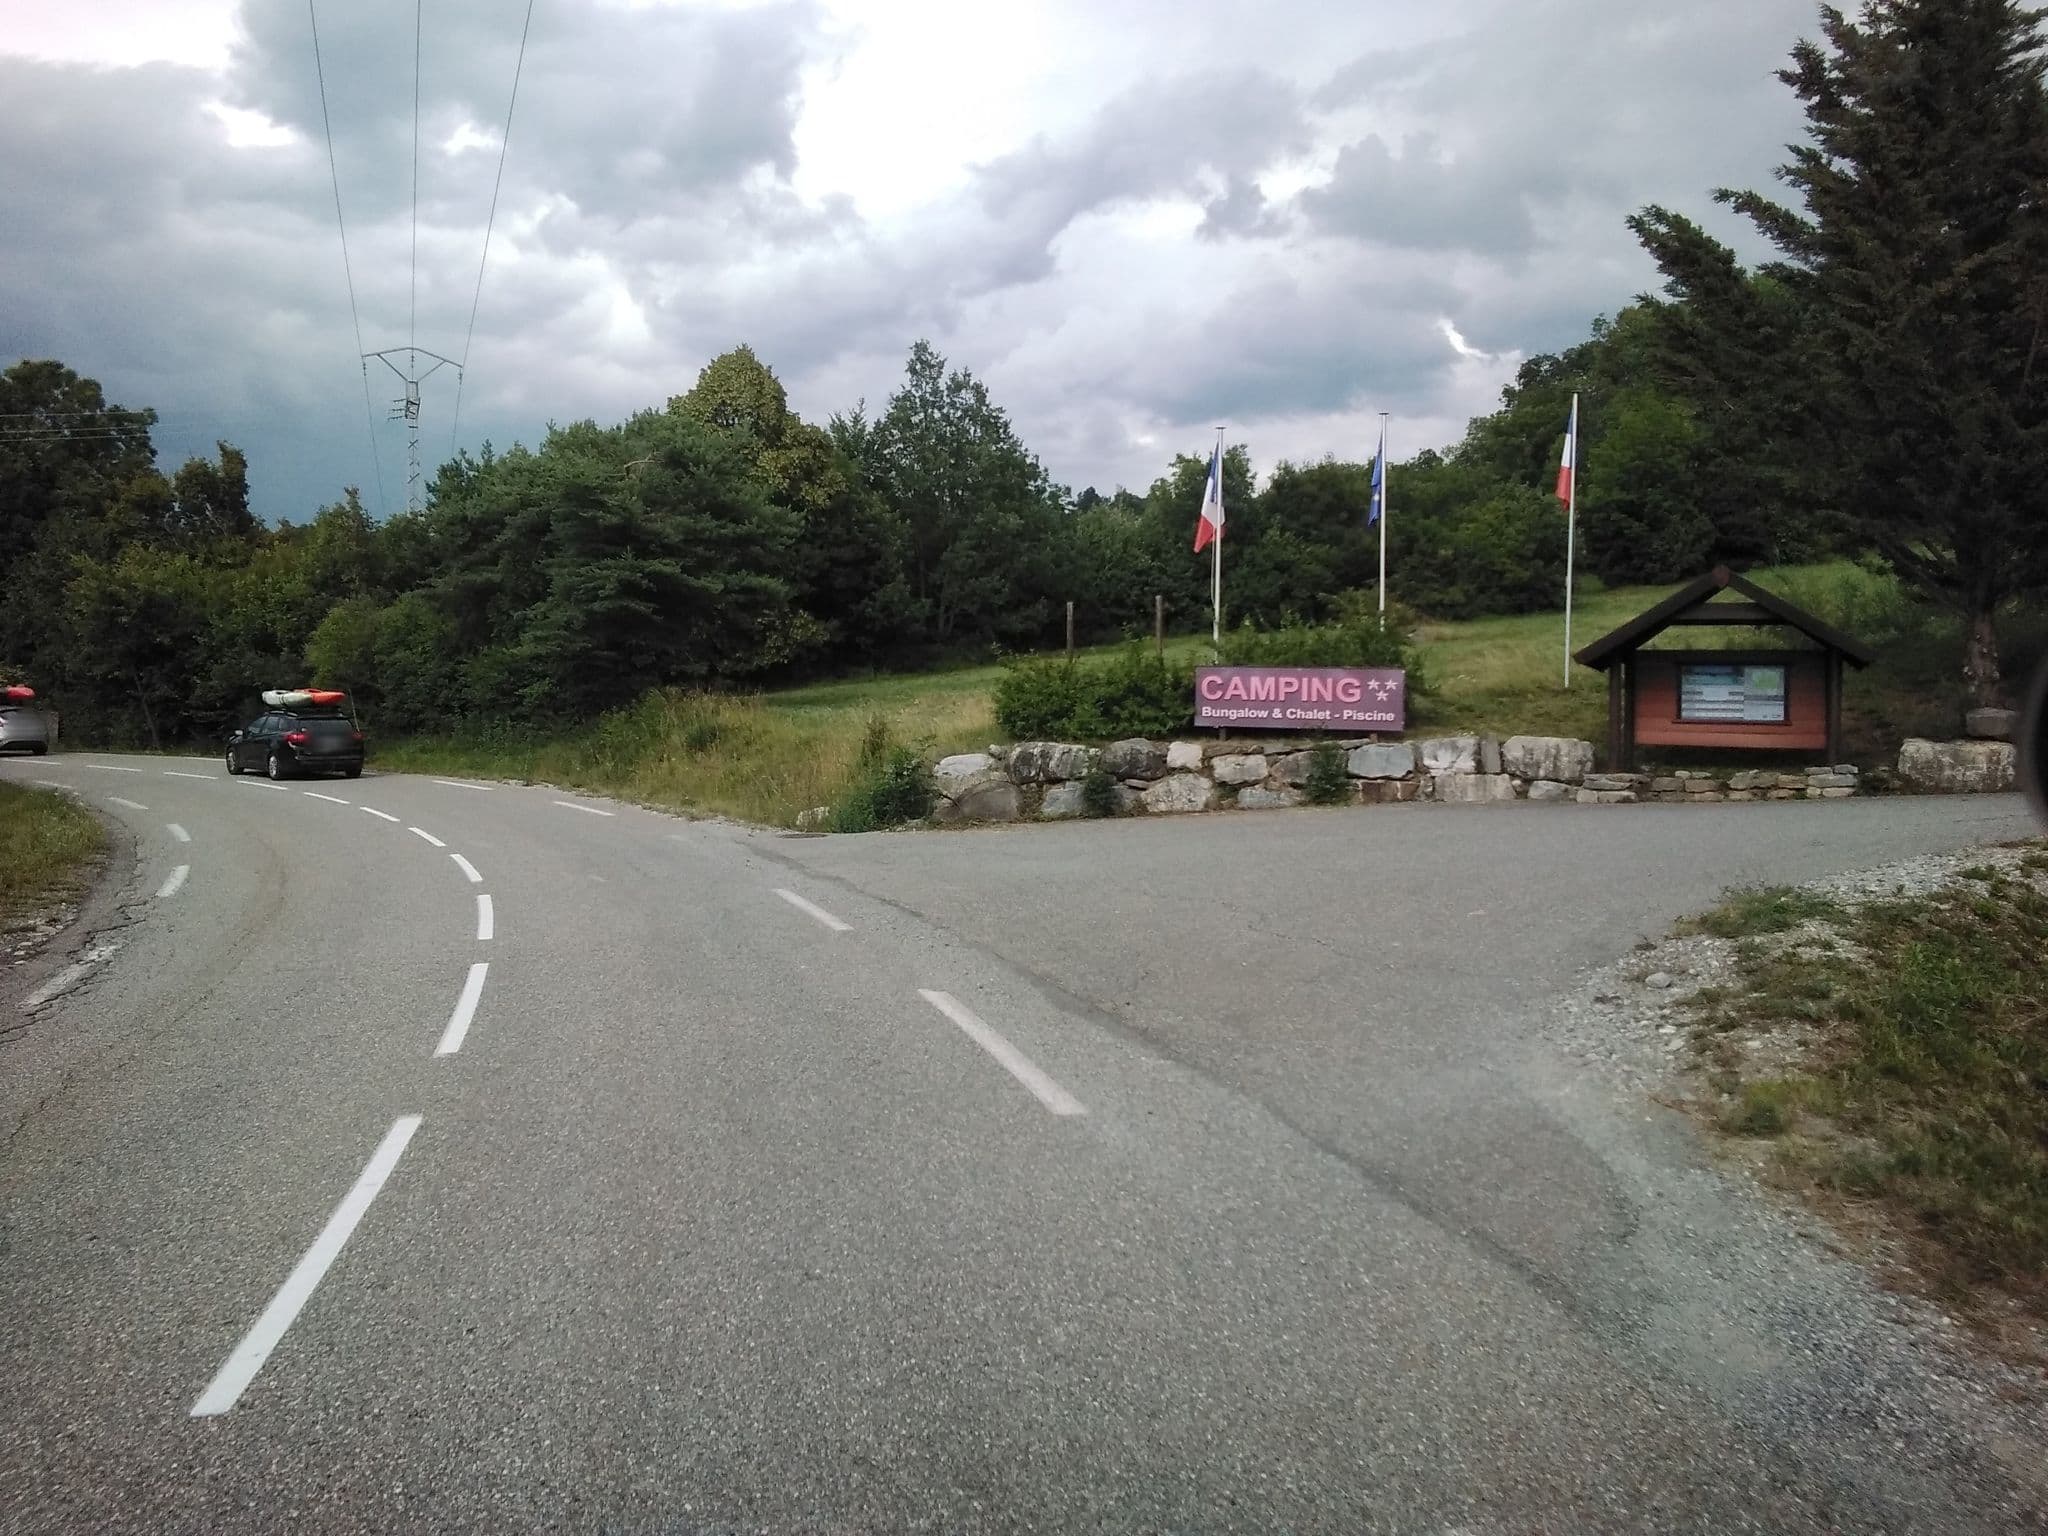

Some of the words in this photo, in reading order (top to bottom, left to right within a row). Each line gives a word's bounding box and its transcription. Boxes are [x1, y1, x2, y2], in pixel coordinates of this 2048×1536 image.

[1201, 675, 1362, 703] CAMPING
[1202, 706, 1269, 721] Bungalow
[1271, 708, 1283, 719] &
[1286, 708, 1331, 720] Chalet
[1343, 709, 1395, 722] Piscine
